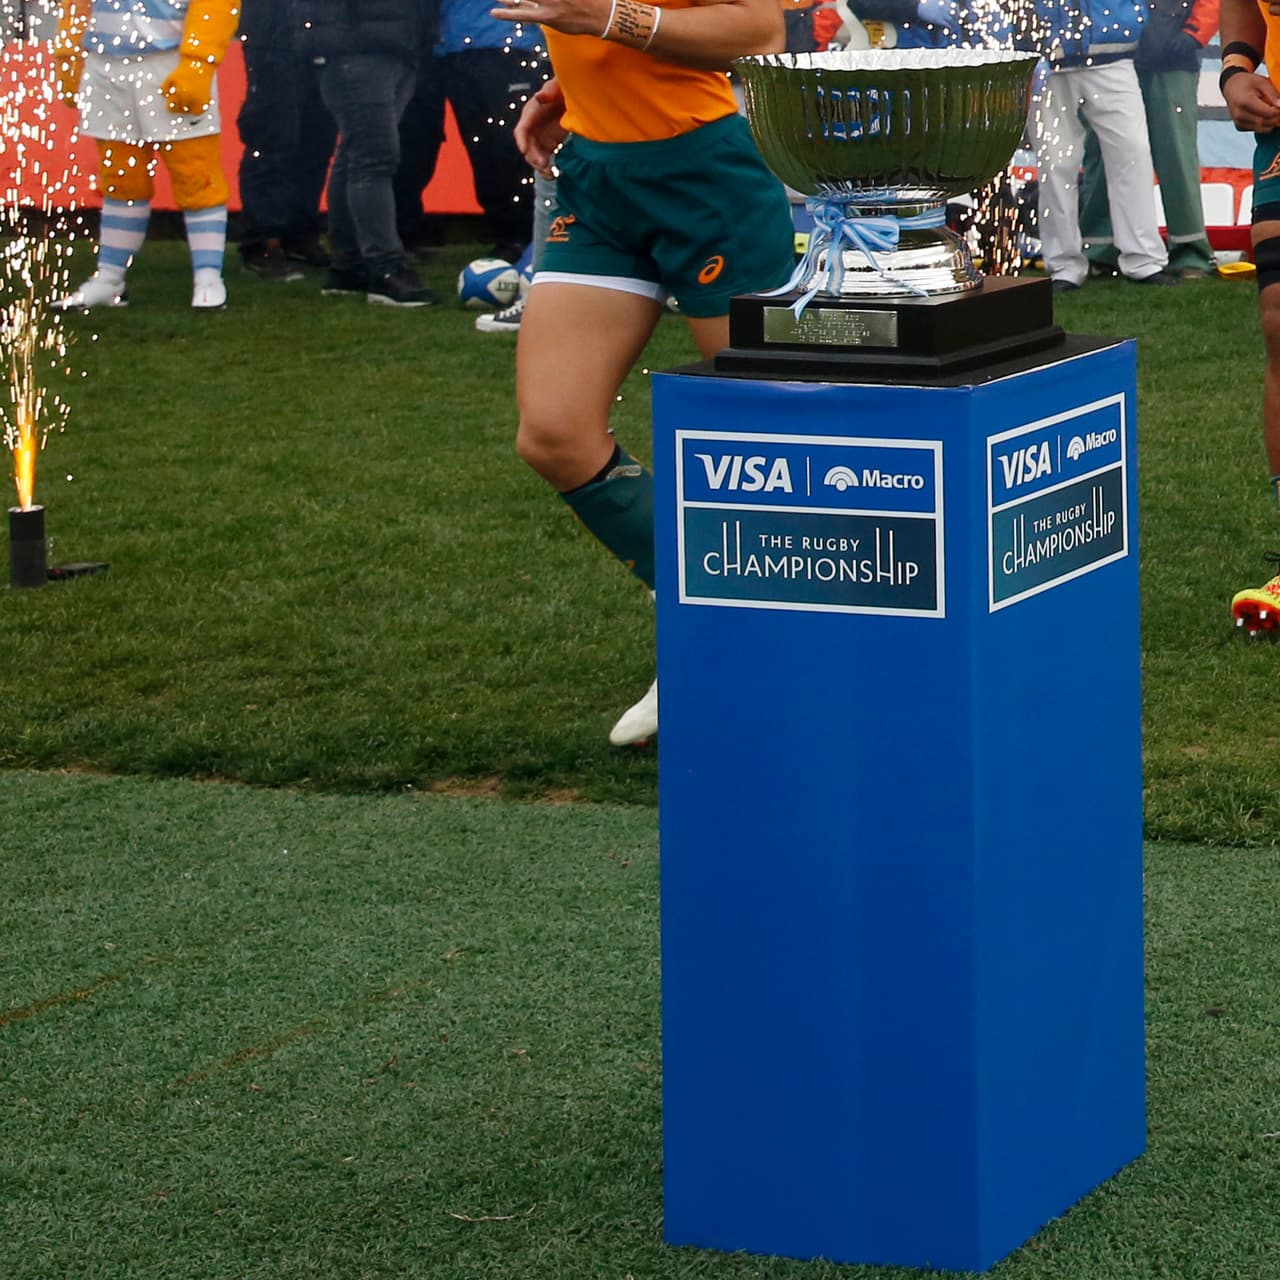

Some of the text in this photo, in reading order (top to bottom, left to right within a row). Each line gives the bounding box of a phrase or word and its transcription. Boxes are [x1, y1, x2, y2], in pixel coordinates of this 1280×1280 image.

[694, 453, 925, 493] VISA Macro
[997, 428, 1117, 489] VISA Macro
[1002, 485, 1116, 575] CHAMPIONSHIP
[1033, 502, 1087, 533] THE RUGBY
[703, 520, 919, 586] CHAMPIONSHIP
[759, 534, 860, 552] THE RUGBY
